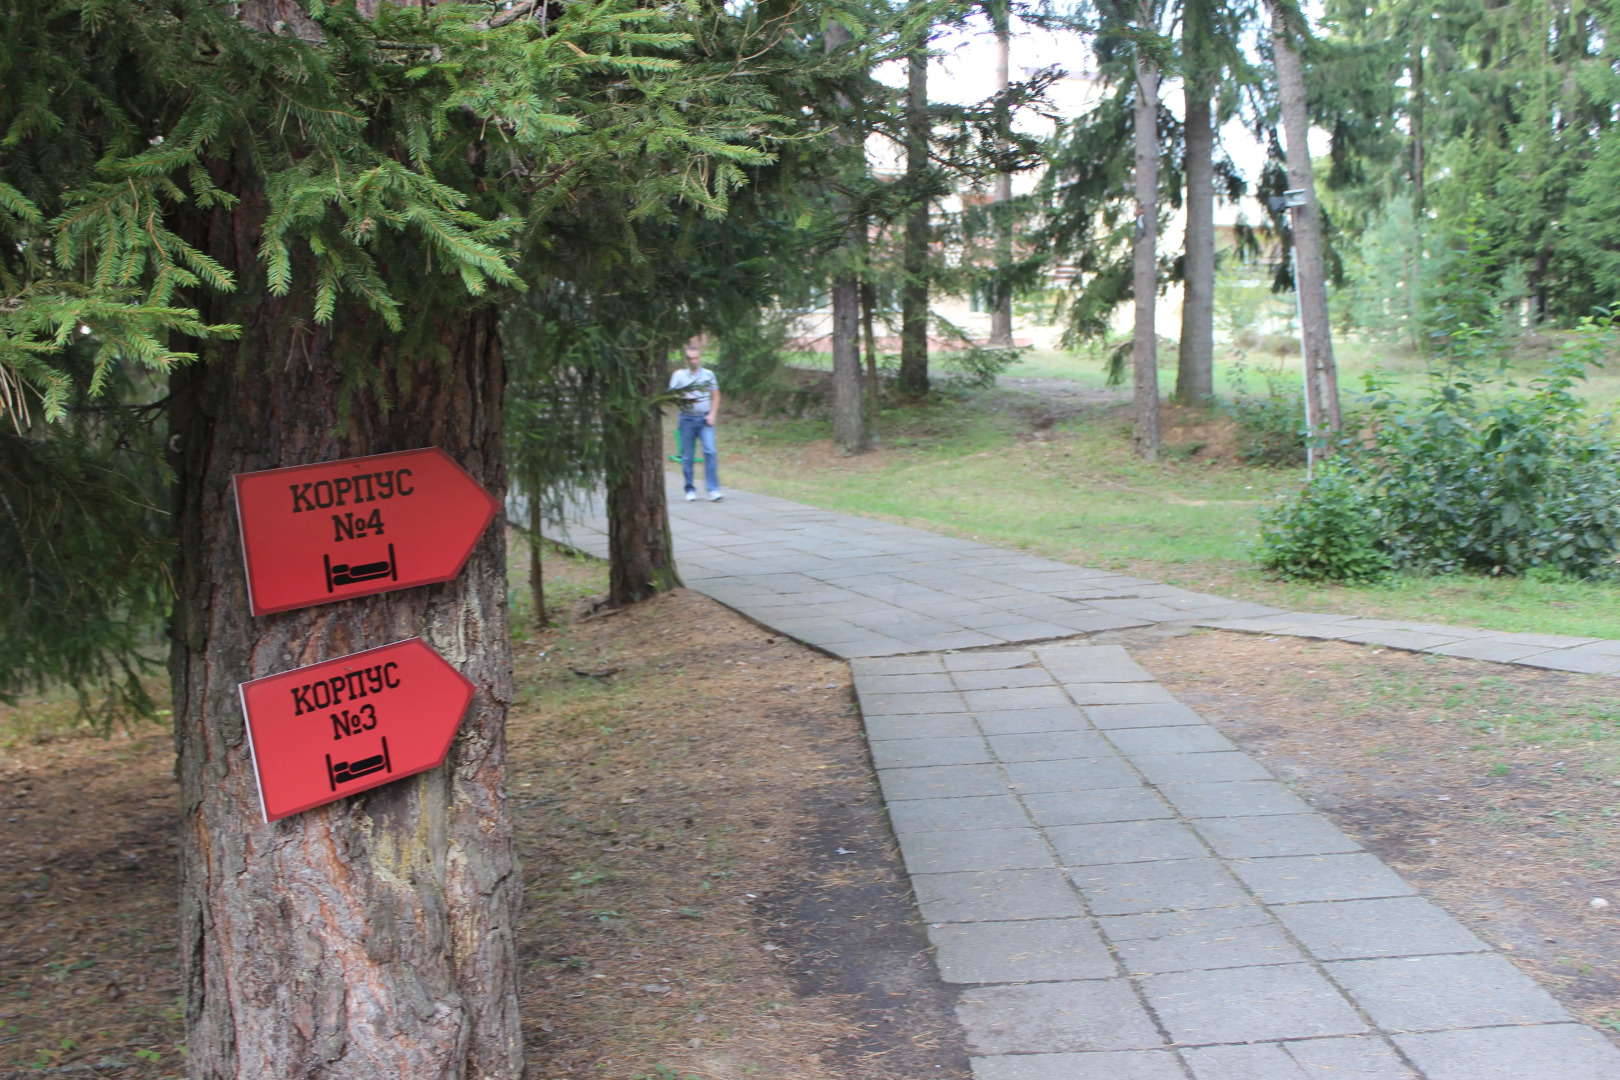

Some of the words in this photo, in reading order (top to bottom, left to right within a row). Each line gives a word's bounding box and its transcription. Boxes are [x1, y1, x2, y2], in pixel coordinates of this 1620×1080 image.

[290, 468, 415, 513] КОРПУС
[332, 508, 385, 542] №4
[291, 661, 401, 716] КОРПУС
[330, 703, 377, 740] №3
